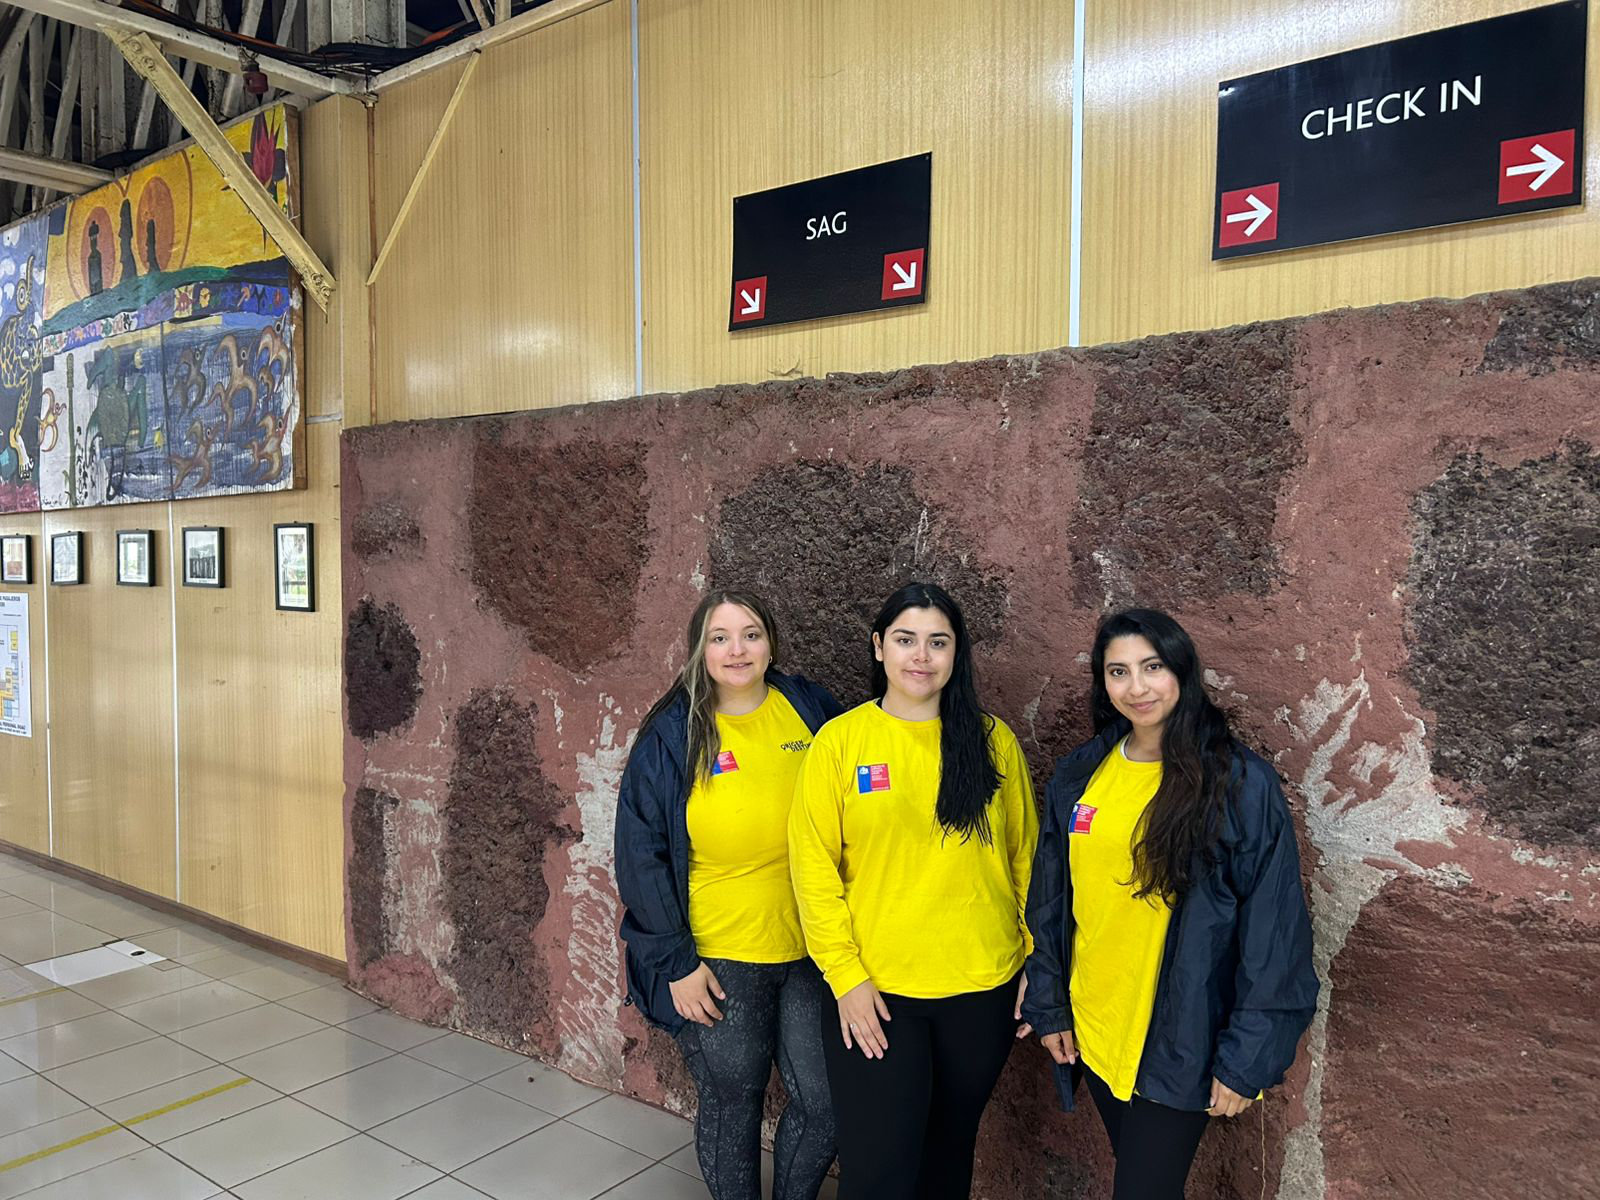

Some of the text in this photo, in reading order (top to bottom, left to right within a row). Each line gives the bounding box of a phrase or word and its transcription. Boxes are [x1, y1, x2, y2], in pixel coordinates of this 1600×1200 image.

[1302, 76, 1482, 140] CHECK IN
[806, 212, 847, 241] SAG
[780, 739, 803, 750] ORIGEN
[790, 742, 811, 752] DESTIN
